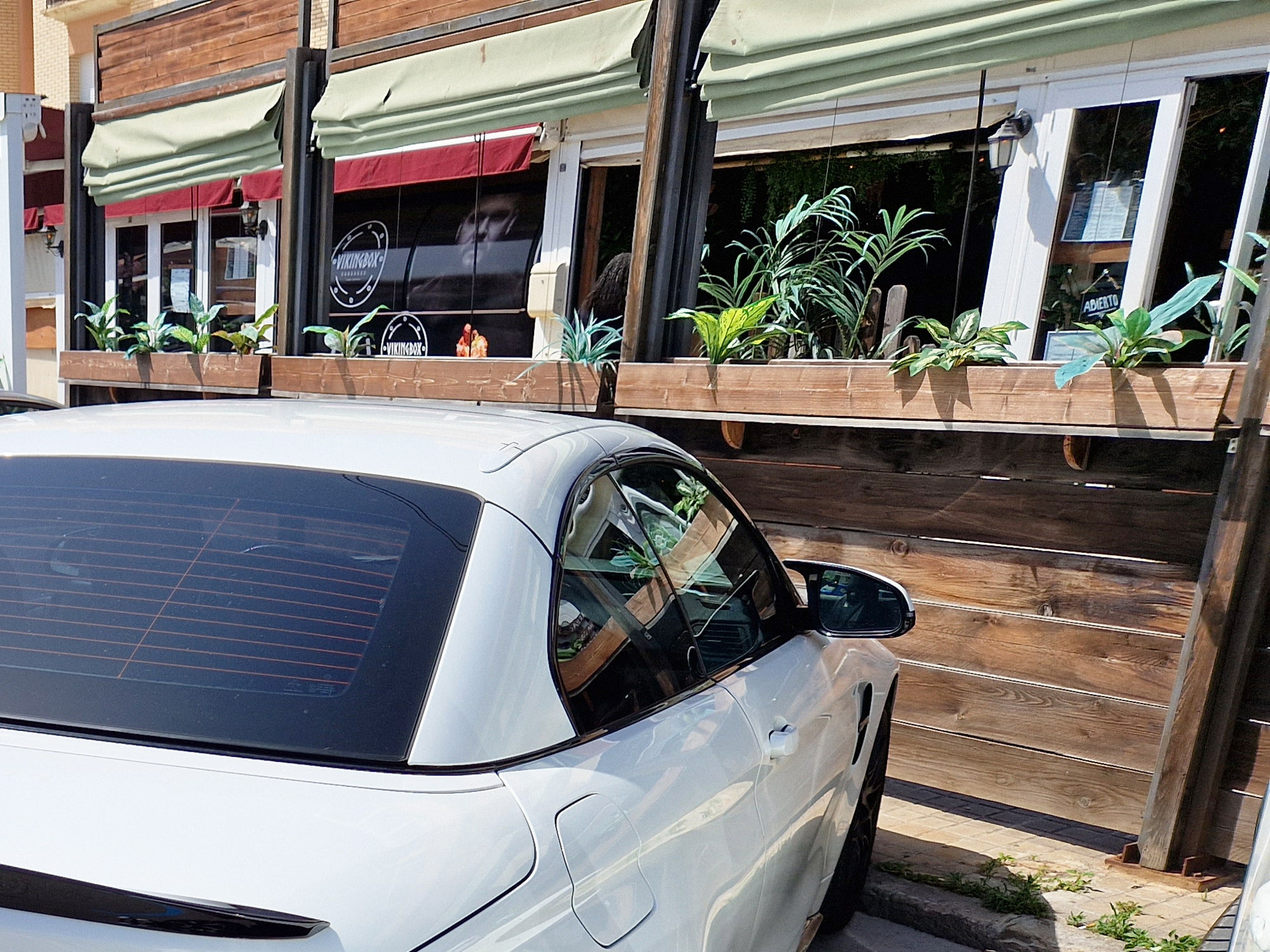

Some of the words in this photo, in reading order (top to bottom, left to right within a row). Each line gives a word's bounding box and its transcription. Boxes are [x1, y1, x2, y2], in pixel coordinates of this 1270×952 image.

[336, 251, 380, 270] VIKINGBOX
[1083, 294, 1119, 313] ABIERTO
[386, 341, 423, 356] VIKINGBOX
